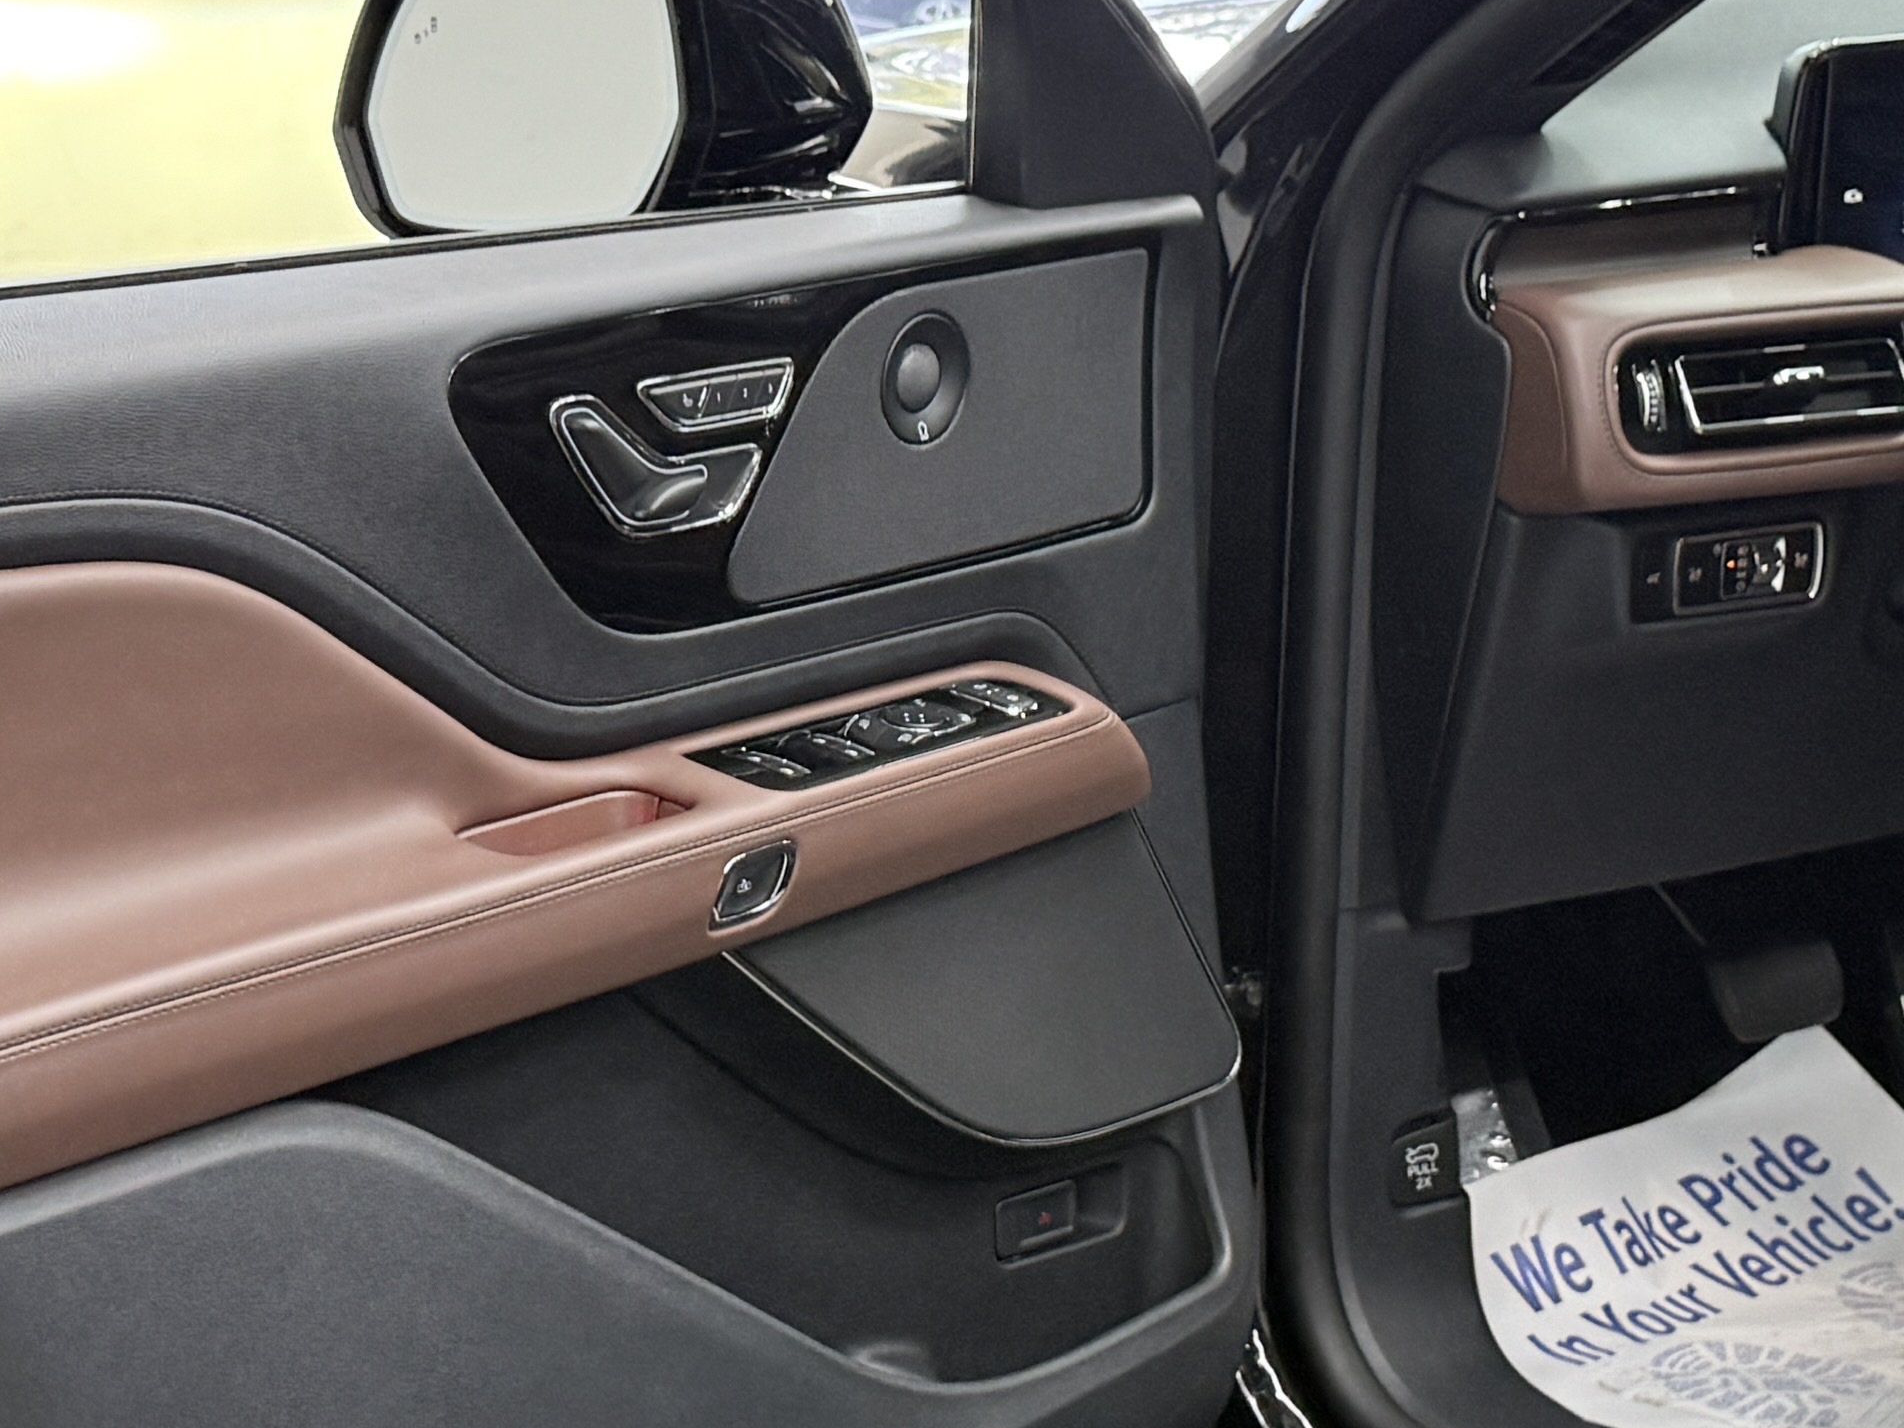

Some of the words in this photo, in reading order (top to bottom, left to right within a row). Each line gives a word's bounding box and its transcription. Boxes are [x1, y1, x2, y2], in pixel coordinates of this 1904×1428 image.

[1490, 1233, 1593, 1313] We
[1578, 1196, 1702, 1275] Take
[1678, 1133, 1831, 1228] Pride
[1527, 1333, 1616, 1367] In
[1580, 1283, 1722, 1344] Your
